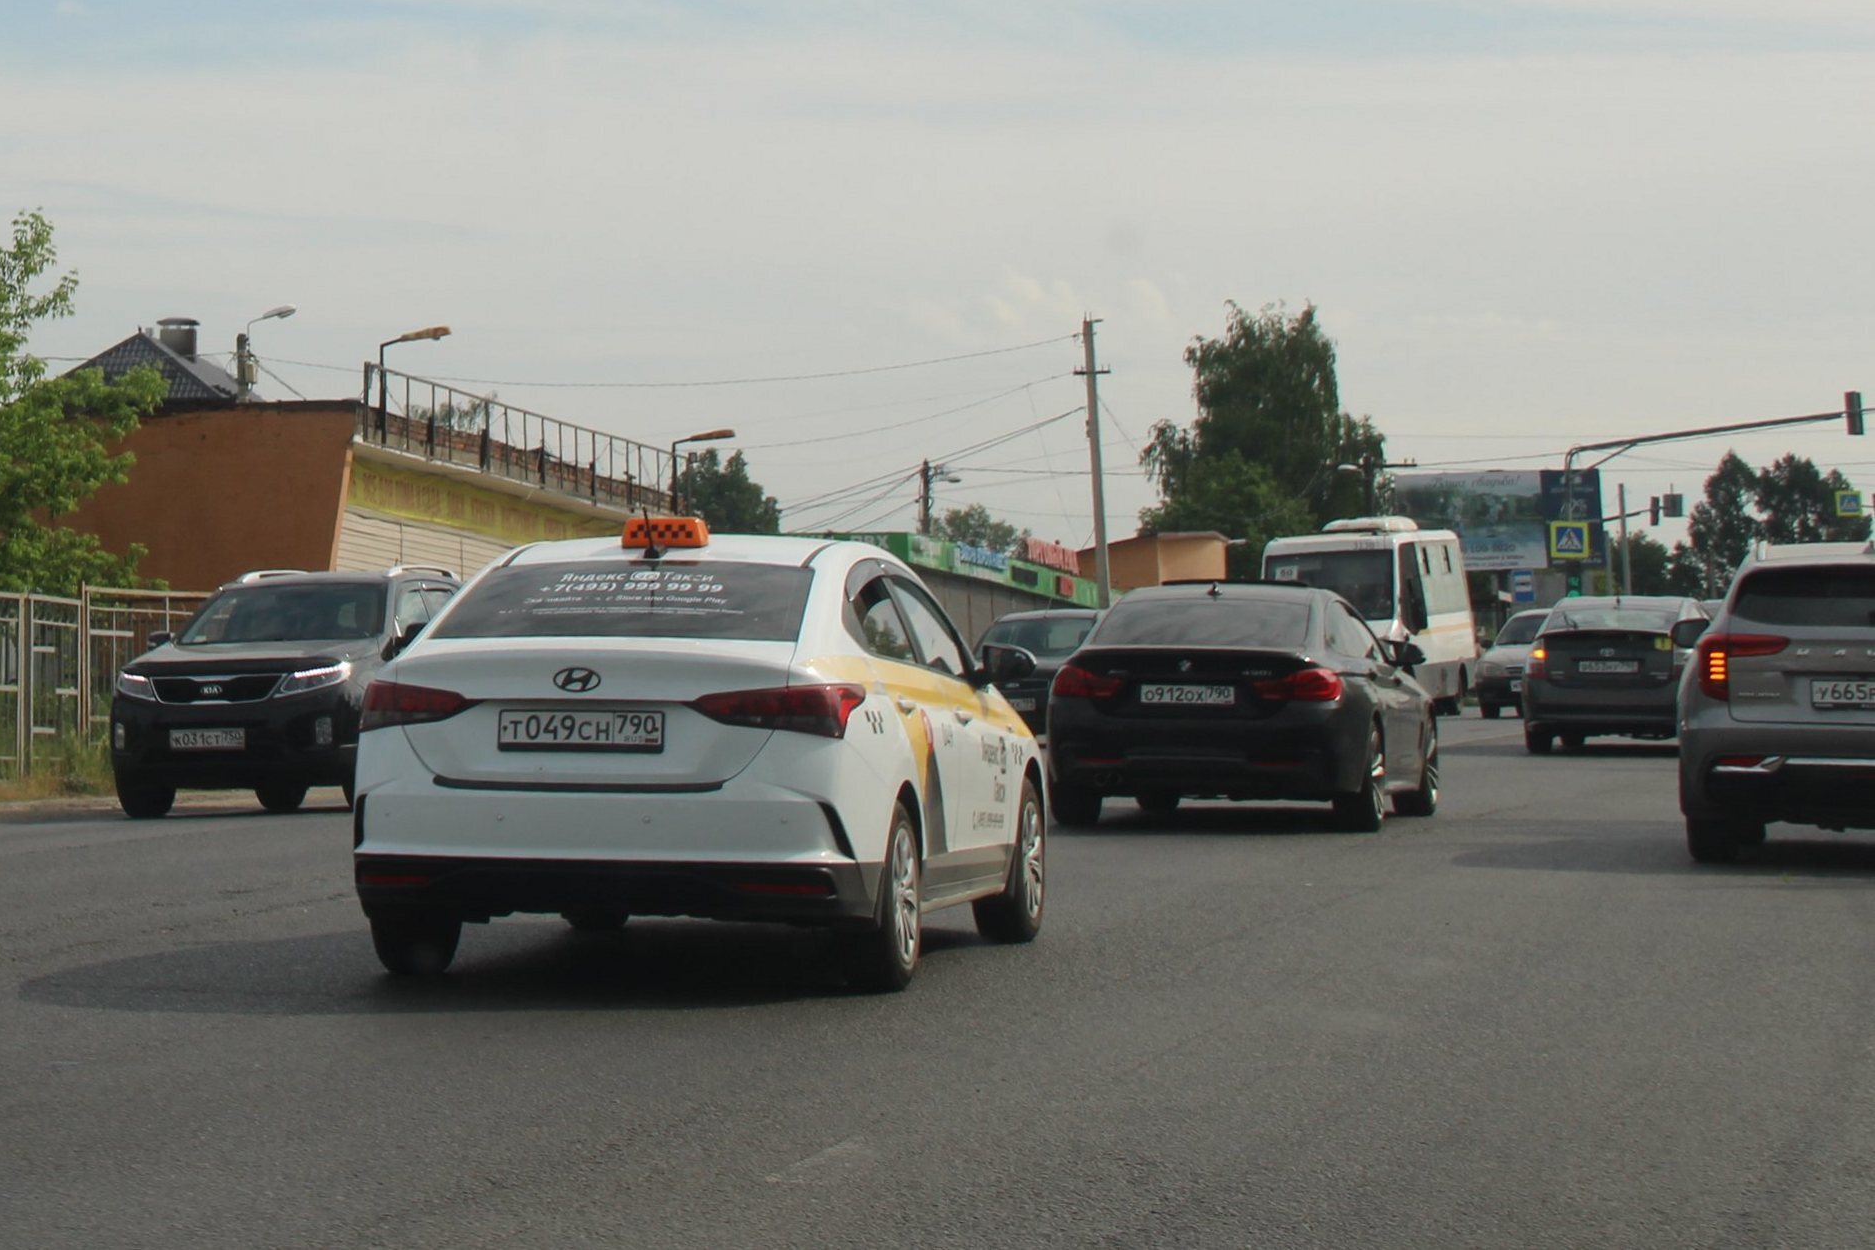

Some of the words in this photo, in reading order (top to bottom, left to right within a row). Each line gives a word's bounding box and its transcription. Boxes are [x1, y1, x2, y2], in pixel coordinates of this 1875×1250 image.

[560, 572, 626, 582] Яндекс
[623, 581, 661, 591] 999
[666, 581, 692, 592] 99
[698, 582, 725, 593] 99
[616, 714, 658, 735] 790
